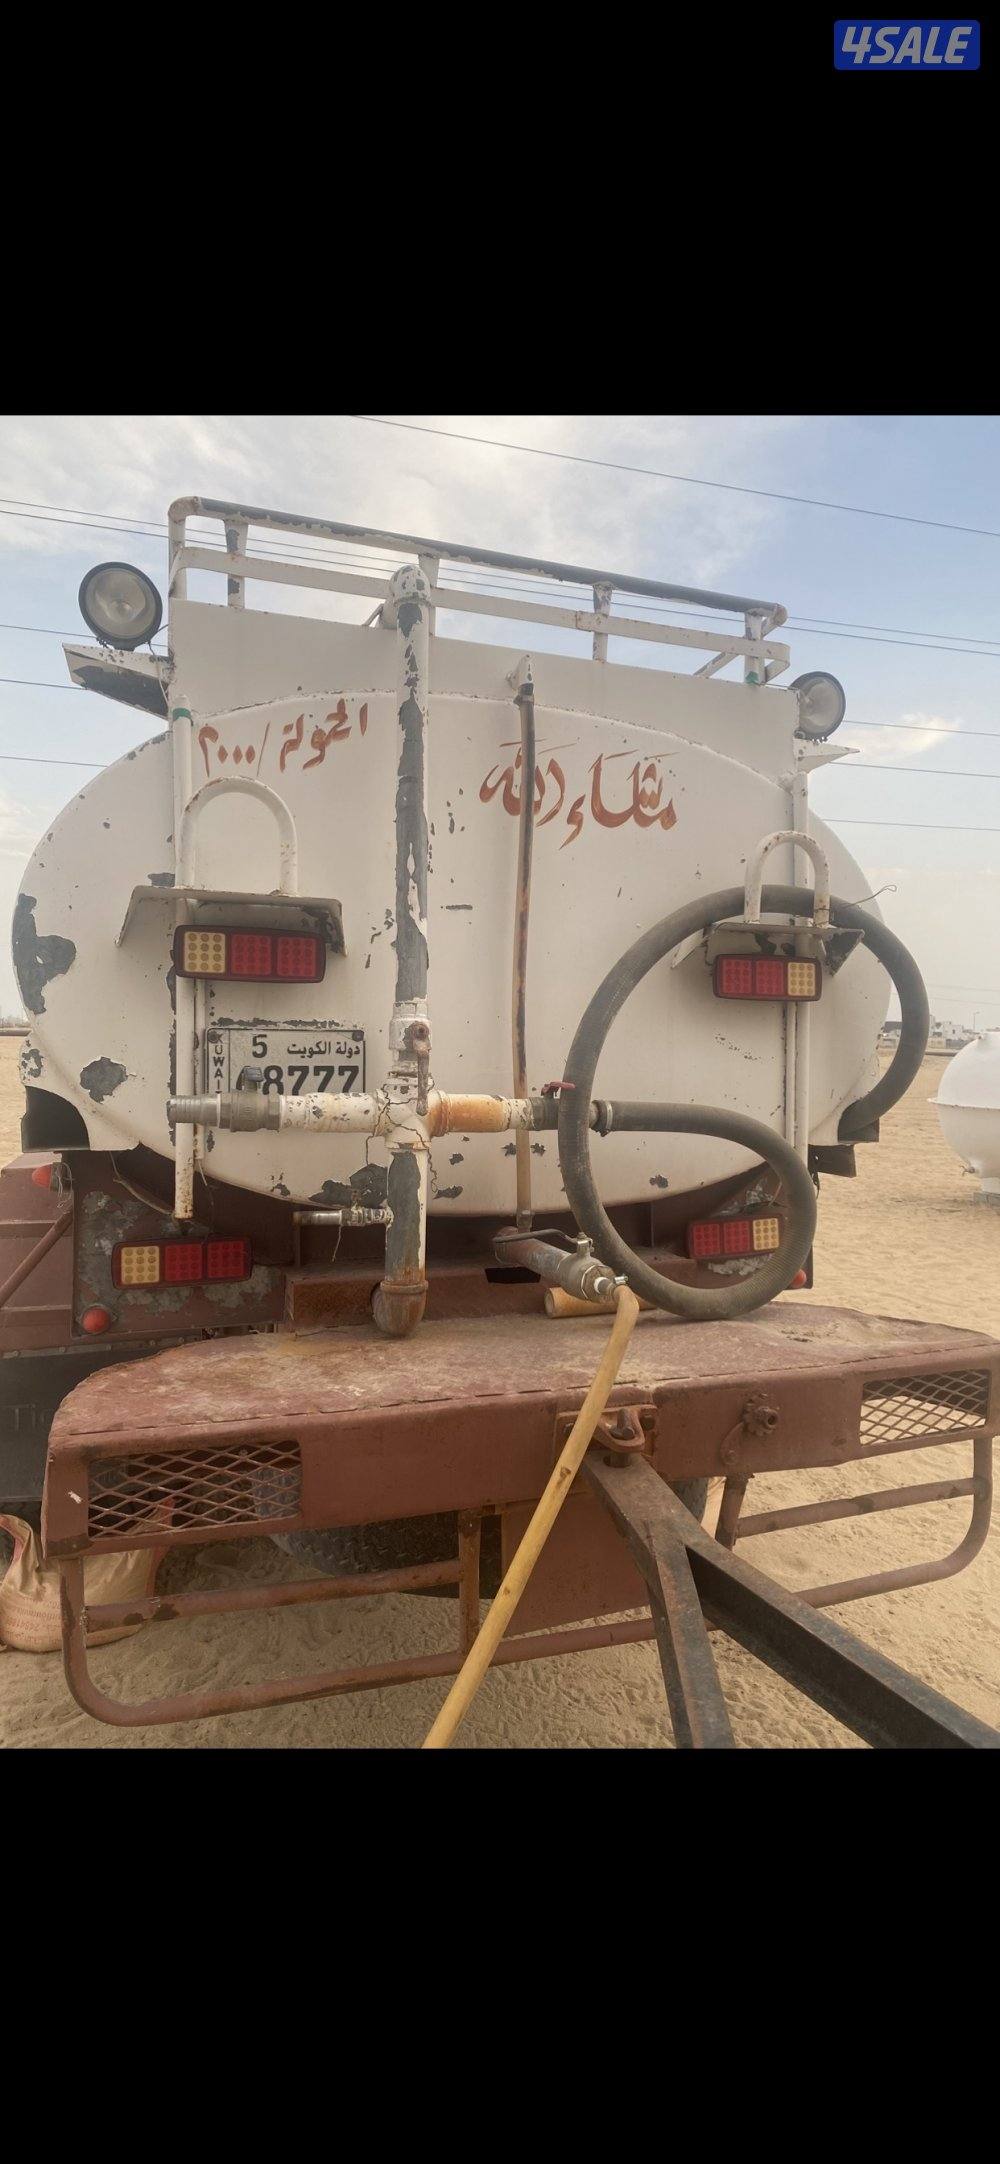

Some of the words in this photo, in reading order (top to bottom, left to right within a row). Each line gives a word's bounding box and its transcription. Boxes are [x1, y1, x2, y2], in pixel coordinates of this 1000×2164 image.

[252, 1034, 268, 1059] 5
[286, 1040, 332, 1059] الكويت
[335, 1041, 361, 1059] دولة
